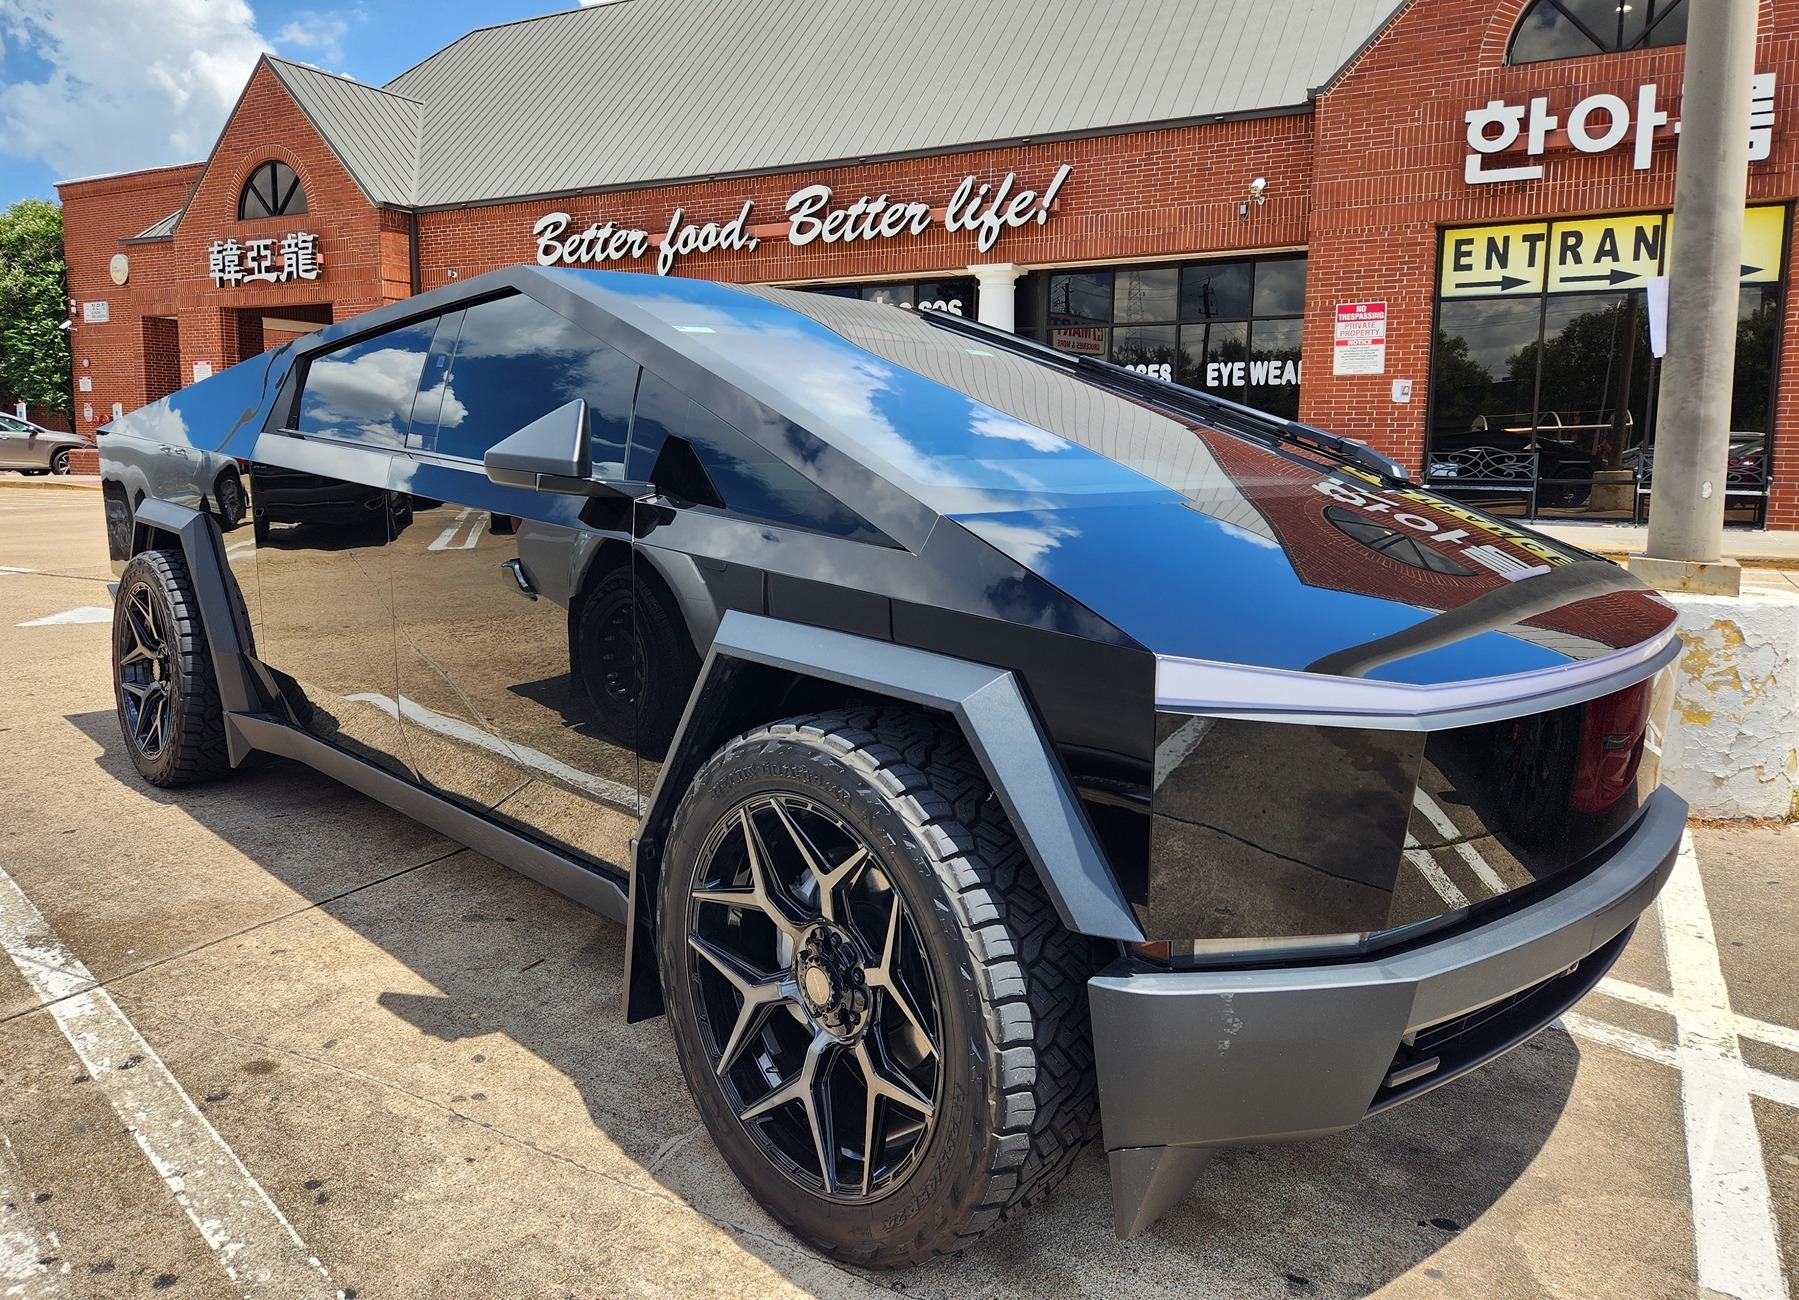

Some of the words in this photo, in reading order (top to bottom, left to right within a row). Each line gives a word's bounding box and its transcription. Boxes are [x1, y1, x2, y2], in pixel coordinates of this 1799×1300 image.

[533, 212, 648, 266] Better
[657, 200, 760, 276] food,
[785, 184, 931, 245] Better
[944, 164, 1073, 253] life!
[208, 232, 322, 288] 韓亞龍
[1453, 225, 1661, 272] ENTRAN
[1338, 312, 1385, 320] TRESPASSING
[1339, 329, 1380, 337] PROPERTY
[1206, 361, 1246, 387] EYE
[1249, 360, 1302, 386] WEA
